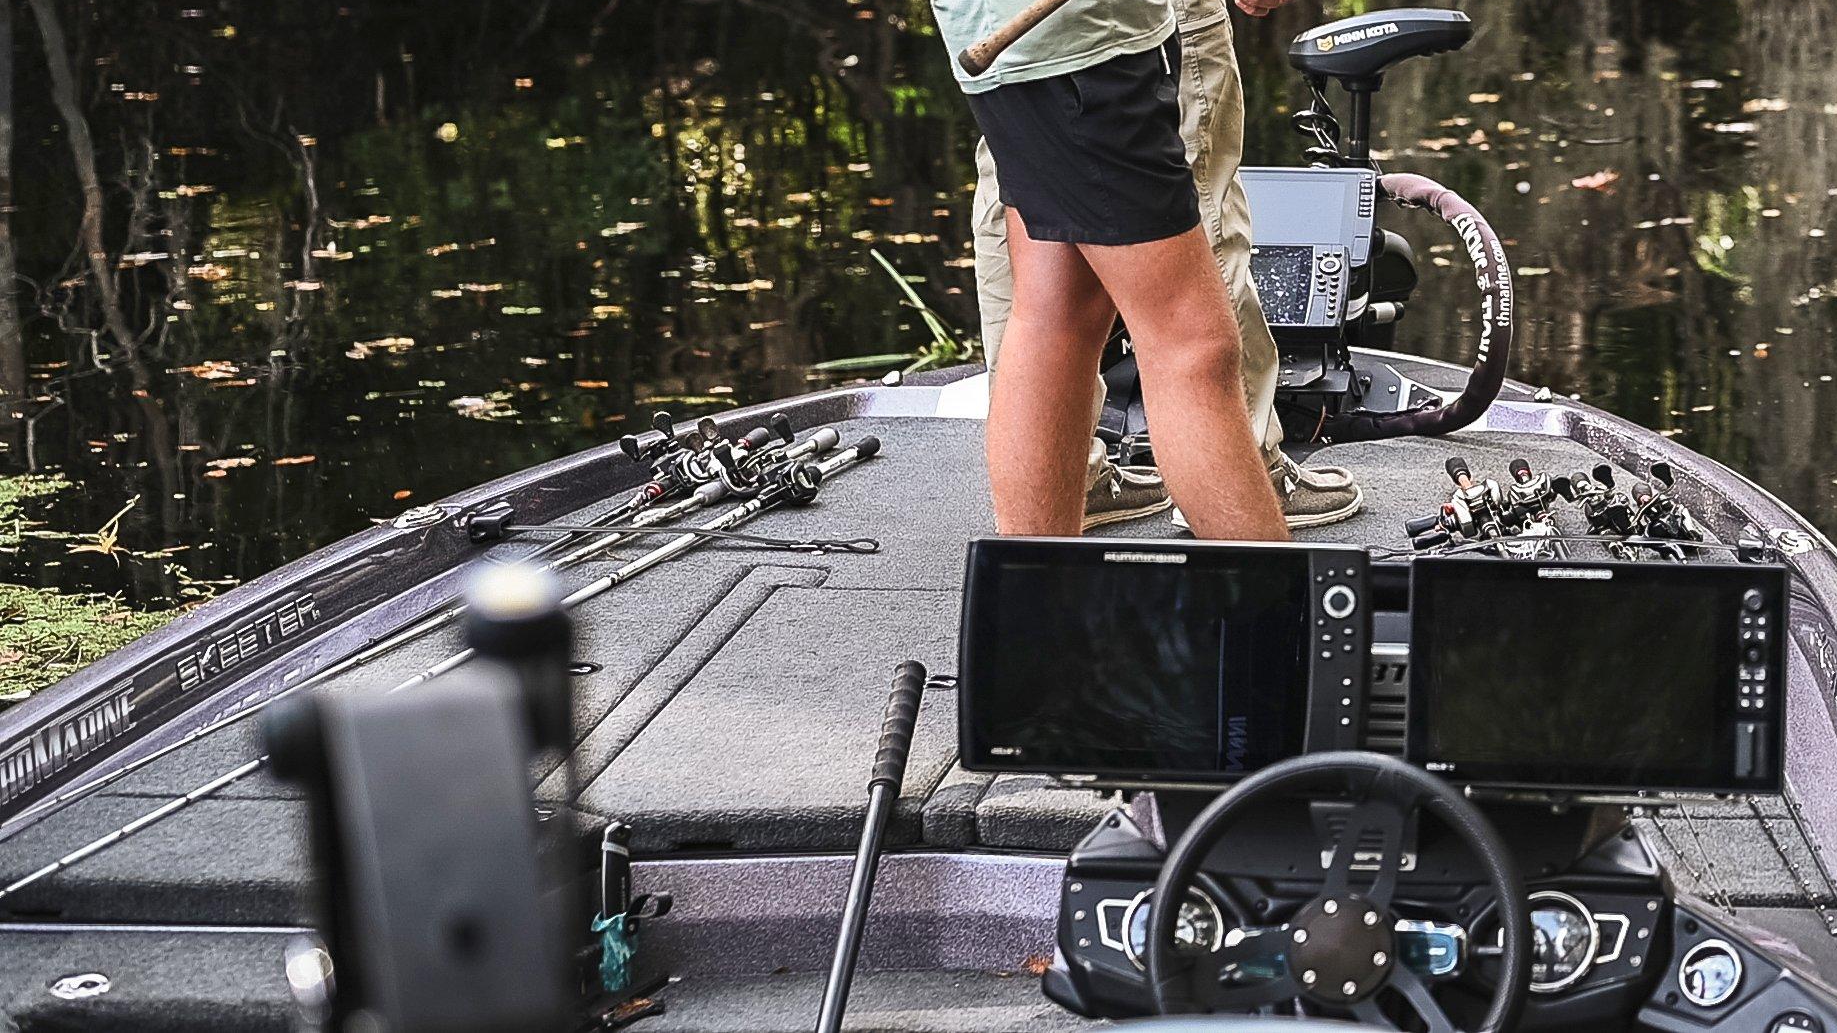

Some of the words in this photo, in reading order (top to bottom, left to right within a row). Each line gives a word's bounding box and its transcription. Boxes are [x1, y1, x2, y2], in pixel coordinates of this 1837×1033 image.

[1334, 29, 1366, 46] MINN
[1365, 23, 1399, 38] KOTA
[1490, 239, 1512, 327] thmarine.com
[177, 592, 320, 692] SKEETER
